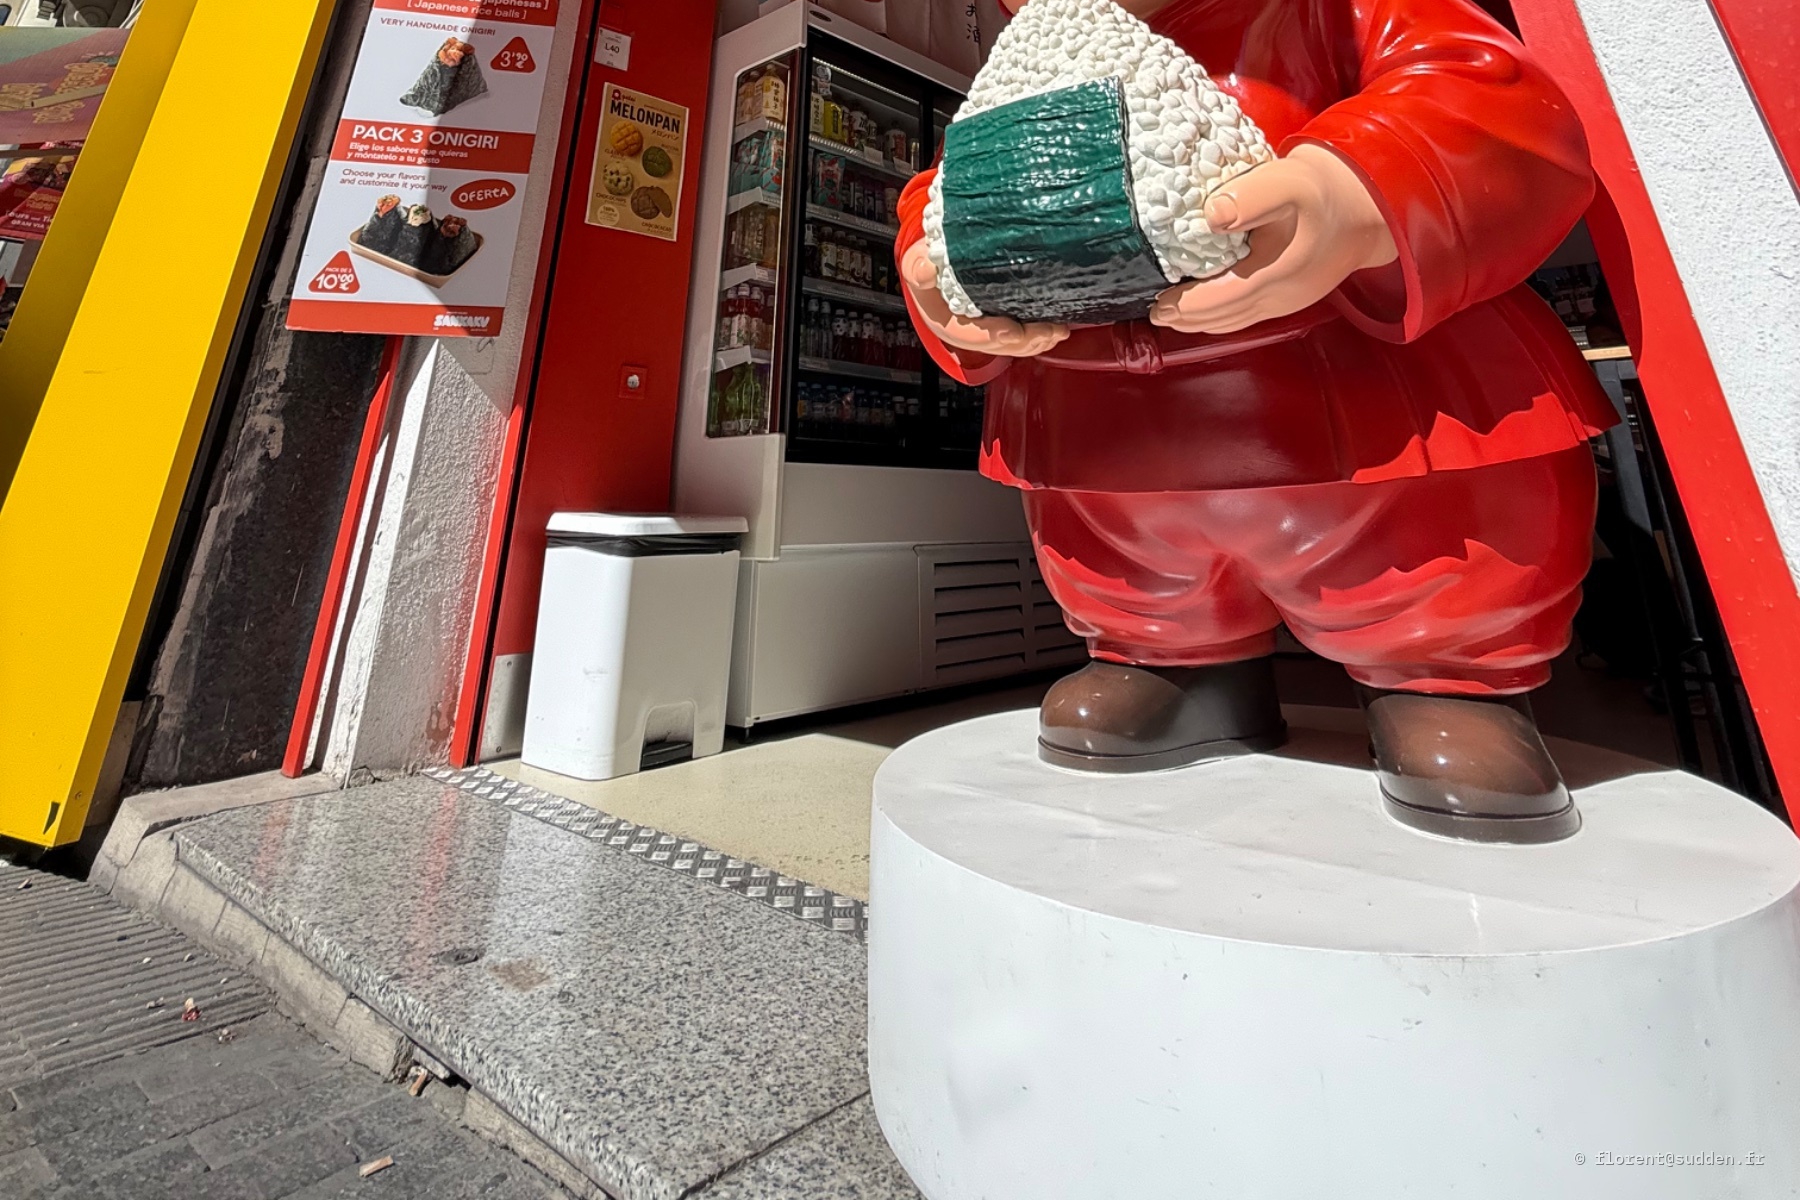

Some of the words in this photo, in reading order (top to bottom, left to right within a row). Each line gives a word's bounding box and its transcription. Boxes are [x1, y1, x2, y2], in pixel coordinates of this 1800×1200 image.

[414, 0, 468, 13] Japanese
[471, 4, 492, 16] rice
[495, 6, 520, 18] balls
[380, 17, 402, 26] VERY
[406, 20, 459, 33] HANDMADE
[460, 26, 496, 36] ONIGIRI
[610, 99, 681, 133] MELONPAN
[352, 124, 407, 142] PACK
[410, 129, 423, 143] 3
[429, 131, 500, 149] ONIGIRI
[349, 142, 369, 152] Elige
[372, 143, 384, 151] los
[386, 145, 419, 154] sabores
[420, 148, 437, 157] que
[438, 149, 468, 158] quieras
[354, 151, 397, 161] móntatelo
[407, 155, 416, 163] tu
[417, 156, 440, 165] gusto
[342, 169, 375, 178] Choose
[377, 171, 396, 181] your
[398, 172, 426, 181] flavors
[339, 177, 355, 185] and
[358, 178, 400, 188] customize
[410, 183, 430, 191] your
[431, 184, 448, 192] way
[459, 187, 510, 203] OFERTA
